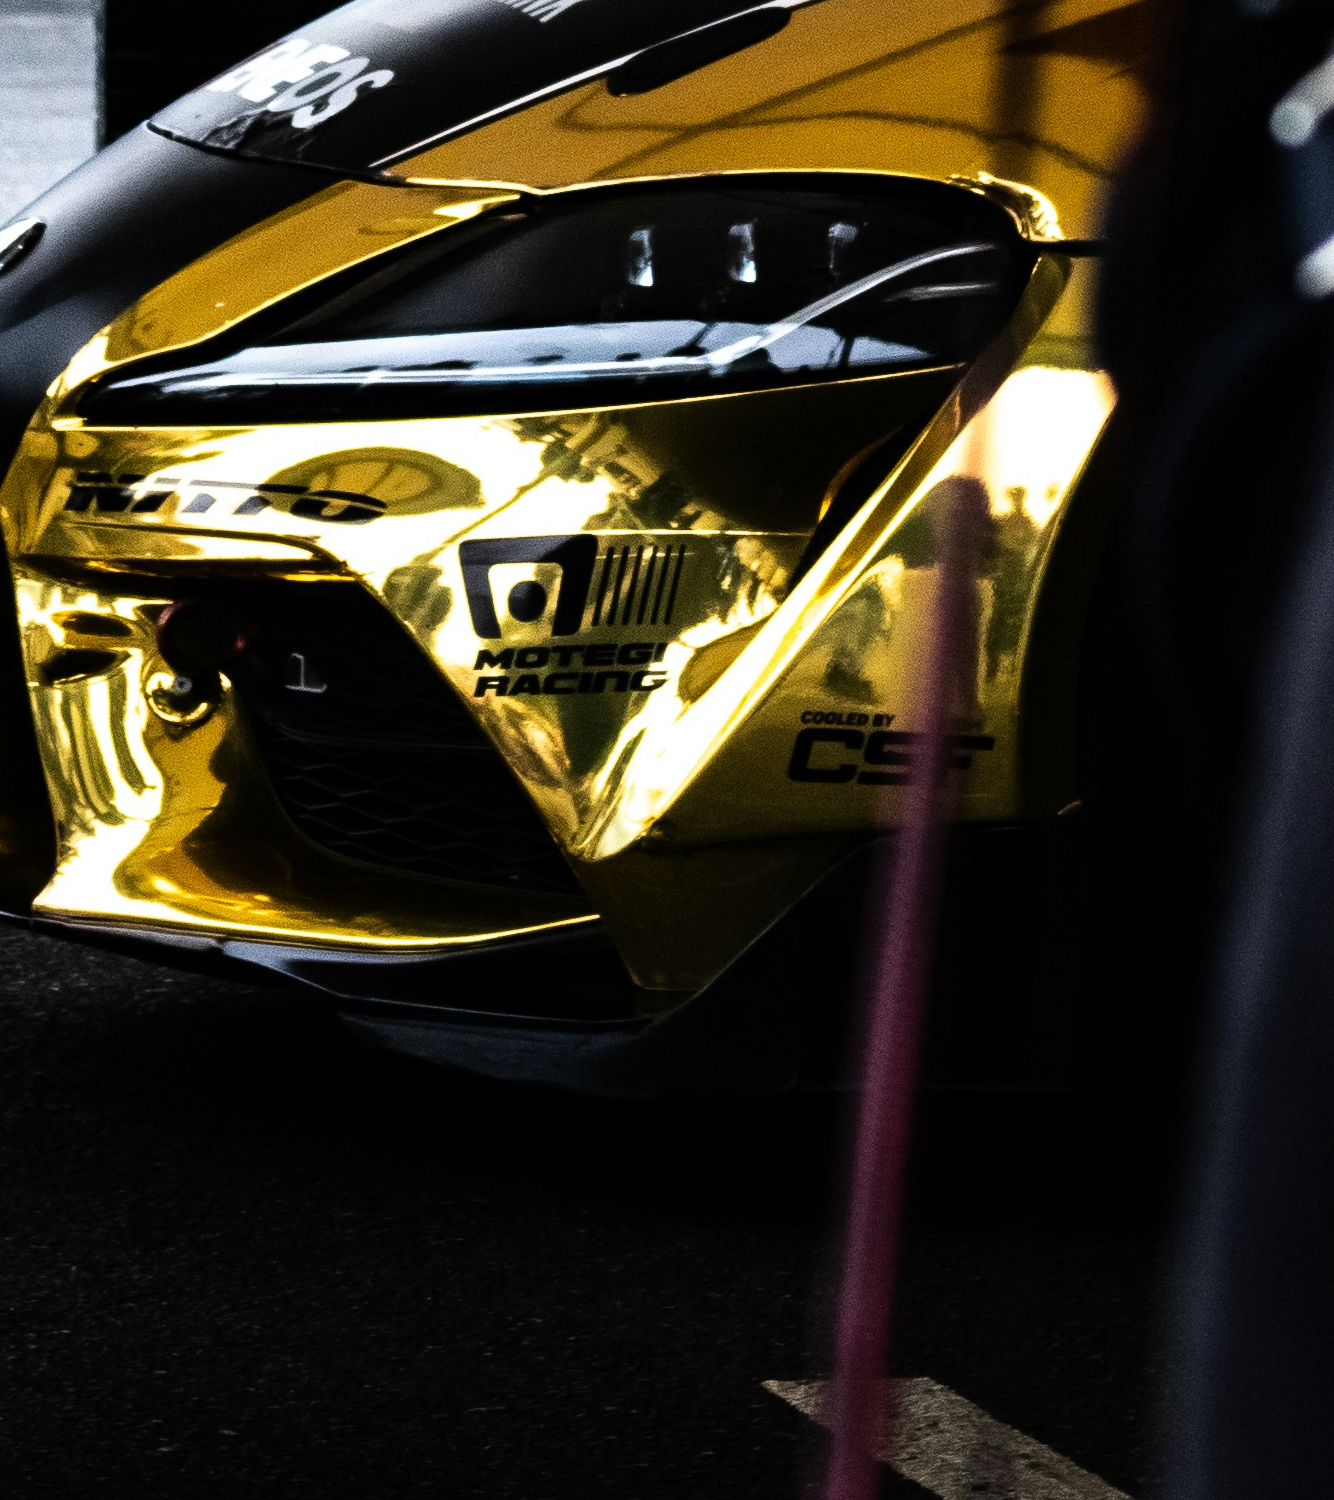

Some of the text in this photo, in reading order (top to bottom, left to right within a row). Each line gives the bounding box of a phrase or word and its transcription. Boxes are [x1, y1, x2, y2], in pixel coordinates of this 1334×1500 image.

[473, 641, 668, 671] MOTEGI
[800, 710, 896, 728] COOLED BY
